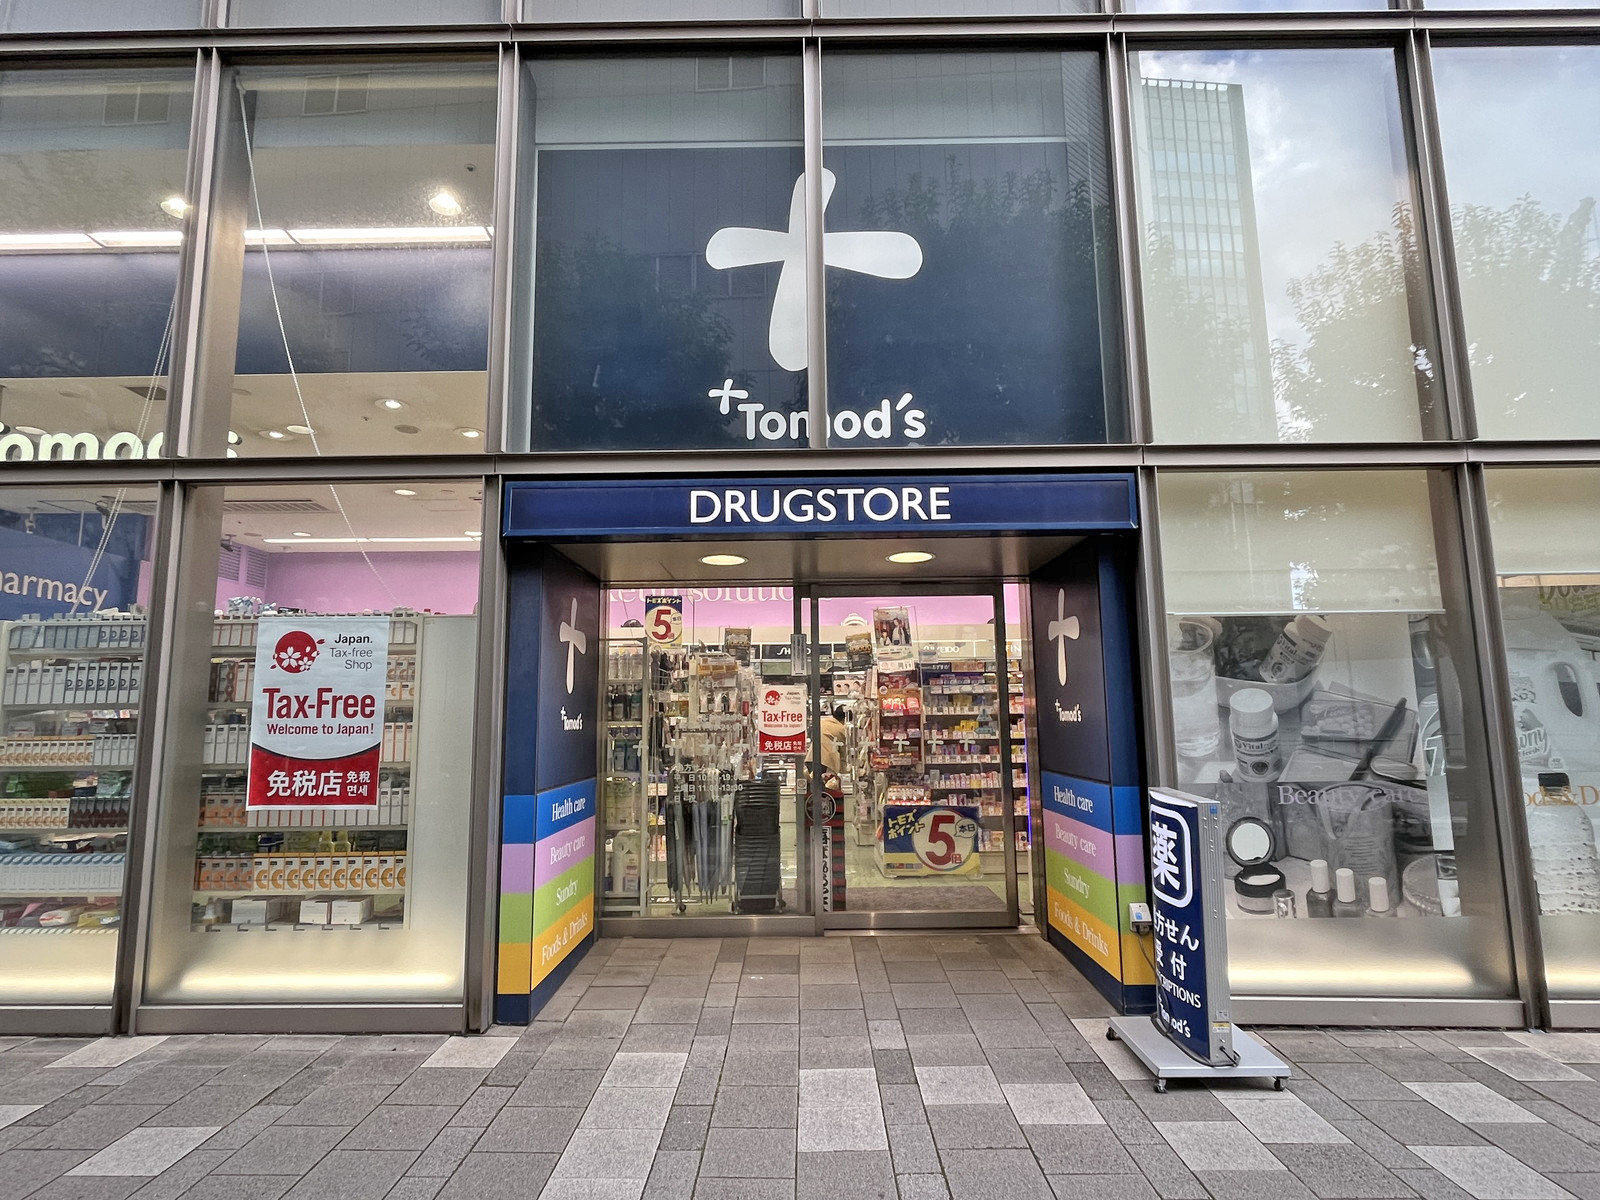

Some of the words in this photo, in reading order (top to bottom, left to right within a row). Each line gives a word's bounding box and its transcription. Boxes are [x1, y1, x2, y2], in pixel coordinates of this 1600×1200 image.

[690, 486, 951, 523] DRUGSTORE
[0, 570, 109, 612] armacy
[651, 609, 671, 640] 5
[330, 647, 373, 658] Tax-free
[334, 633, 373, 646] Japan.
[344, 659, 373, 671] Shop
[262, 687, 376, 719] Tax-Free
[761, 710, 803, 722] Tax-Free
[1058, 704, 1082, 722] Tomod's
[266, 723, 318, 735] Welcome
[322, 724, 334, 735] to
[336, 723, 374, 737] Japan!
[764, 740, 792, 751] 免税店
[266, 769, 343, 797] 免税店
[346, 784, 368, 797] 면세
[551, 797, 573, 822] Health
[573, 797, 586, 812] care
[1053, 786, 1076, 807] Health
[1077, 796, 1094, 813] care
[888, 809, 917, 828] トモズ
[888, 821, 925, 840] ポイント
[958, 823, 976, 834] 本日
[550, 839, 572, 865] Beauty
[573, 835, 585, 852] care
[925, 815, 956, 866] 5
[1055, 823, 1079, 850] Beauty
[1080, 837, 1097, 857] care
[1152, 820, 1181, 891] 薬
[556, 879, 578, 906] Sundry
[1064, 867, 1090, 898] Sundry
[541, 941, 562, 966] Foods
[562, 927, 568, 946] &
[569, 911, 588, 939] Drinks
[1054, 902, 1073, 928] Foods
[1074, 916, 1081, 934] &
[1082, 923, 1109, 957] Drinks
[1153, 906, 1199, 951] 方せん
